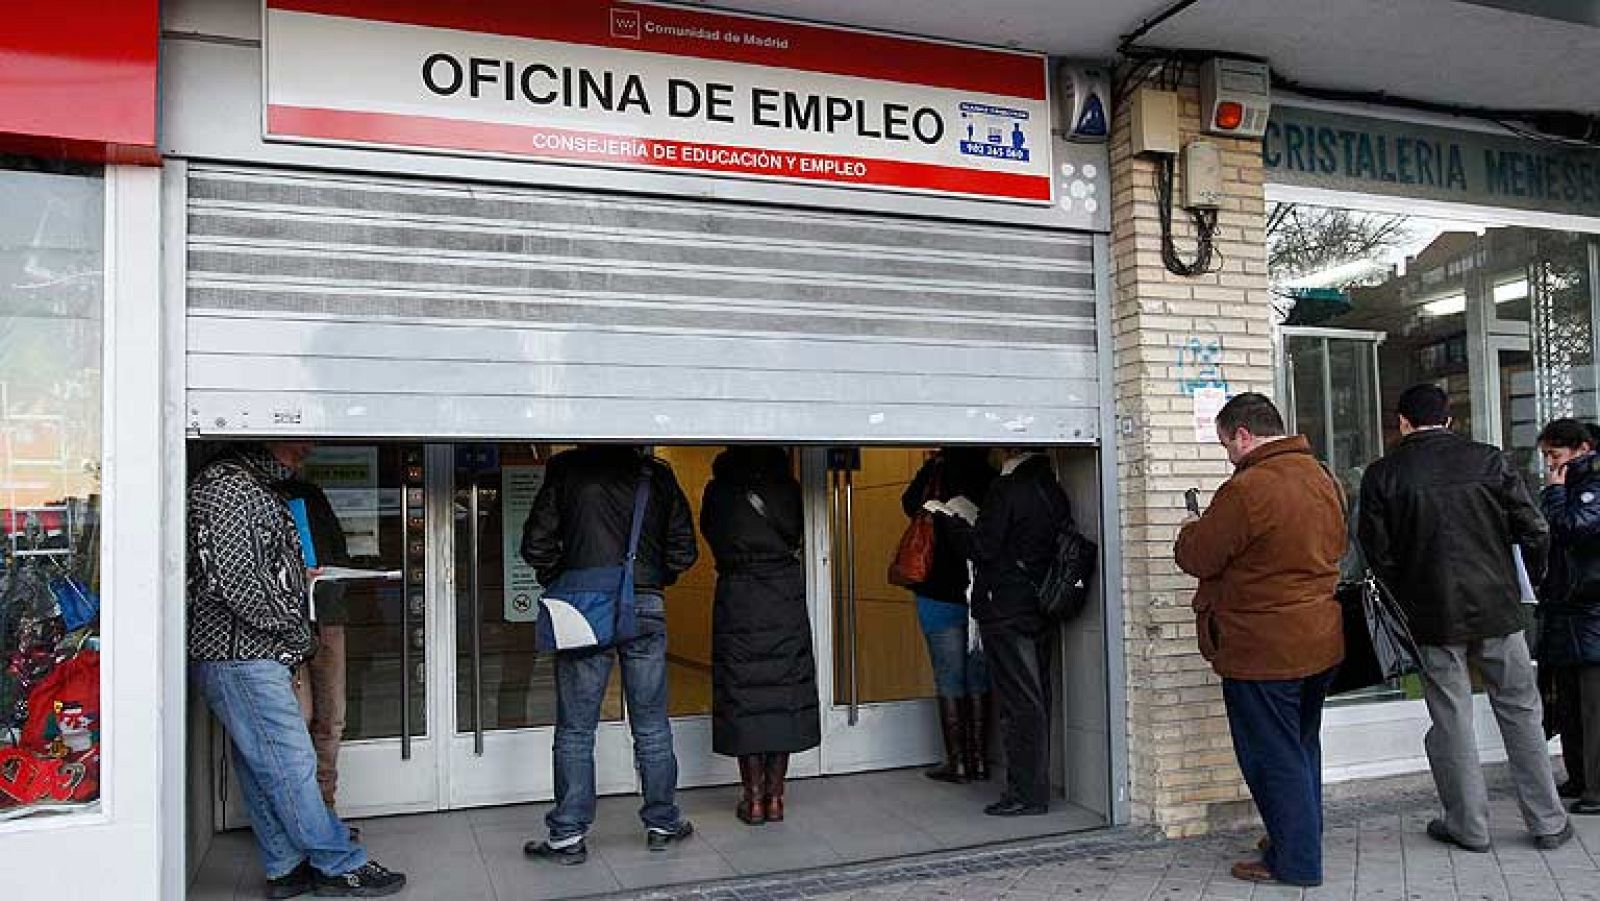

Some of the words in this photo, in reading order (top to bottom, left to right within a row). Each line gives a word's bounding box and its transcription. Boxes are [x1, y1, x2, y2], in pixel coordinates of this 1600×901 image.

[644, 21, 719, 42] Comunidad
[722, 31, 741, 44] de
[744, 32, 789, 49] Madrid
[421, 53, 652, 115] OFICINA
[668, 78, 734, 123] DE
[752, 87, 945, 145] EMPLEO
[532, 132, 648, 158] CONSEJERÍA
[654, 143, 677, 160] DE
[681, 145, 782, 170] EDUCACIÓN
[786, 155, 797, 171] Y
[800, 157, 867, 177] EMPLEO
[1262, 120, 1468, 192] CRISTALERIA
